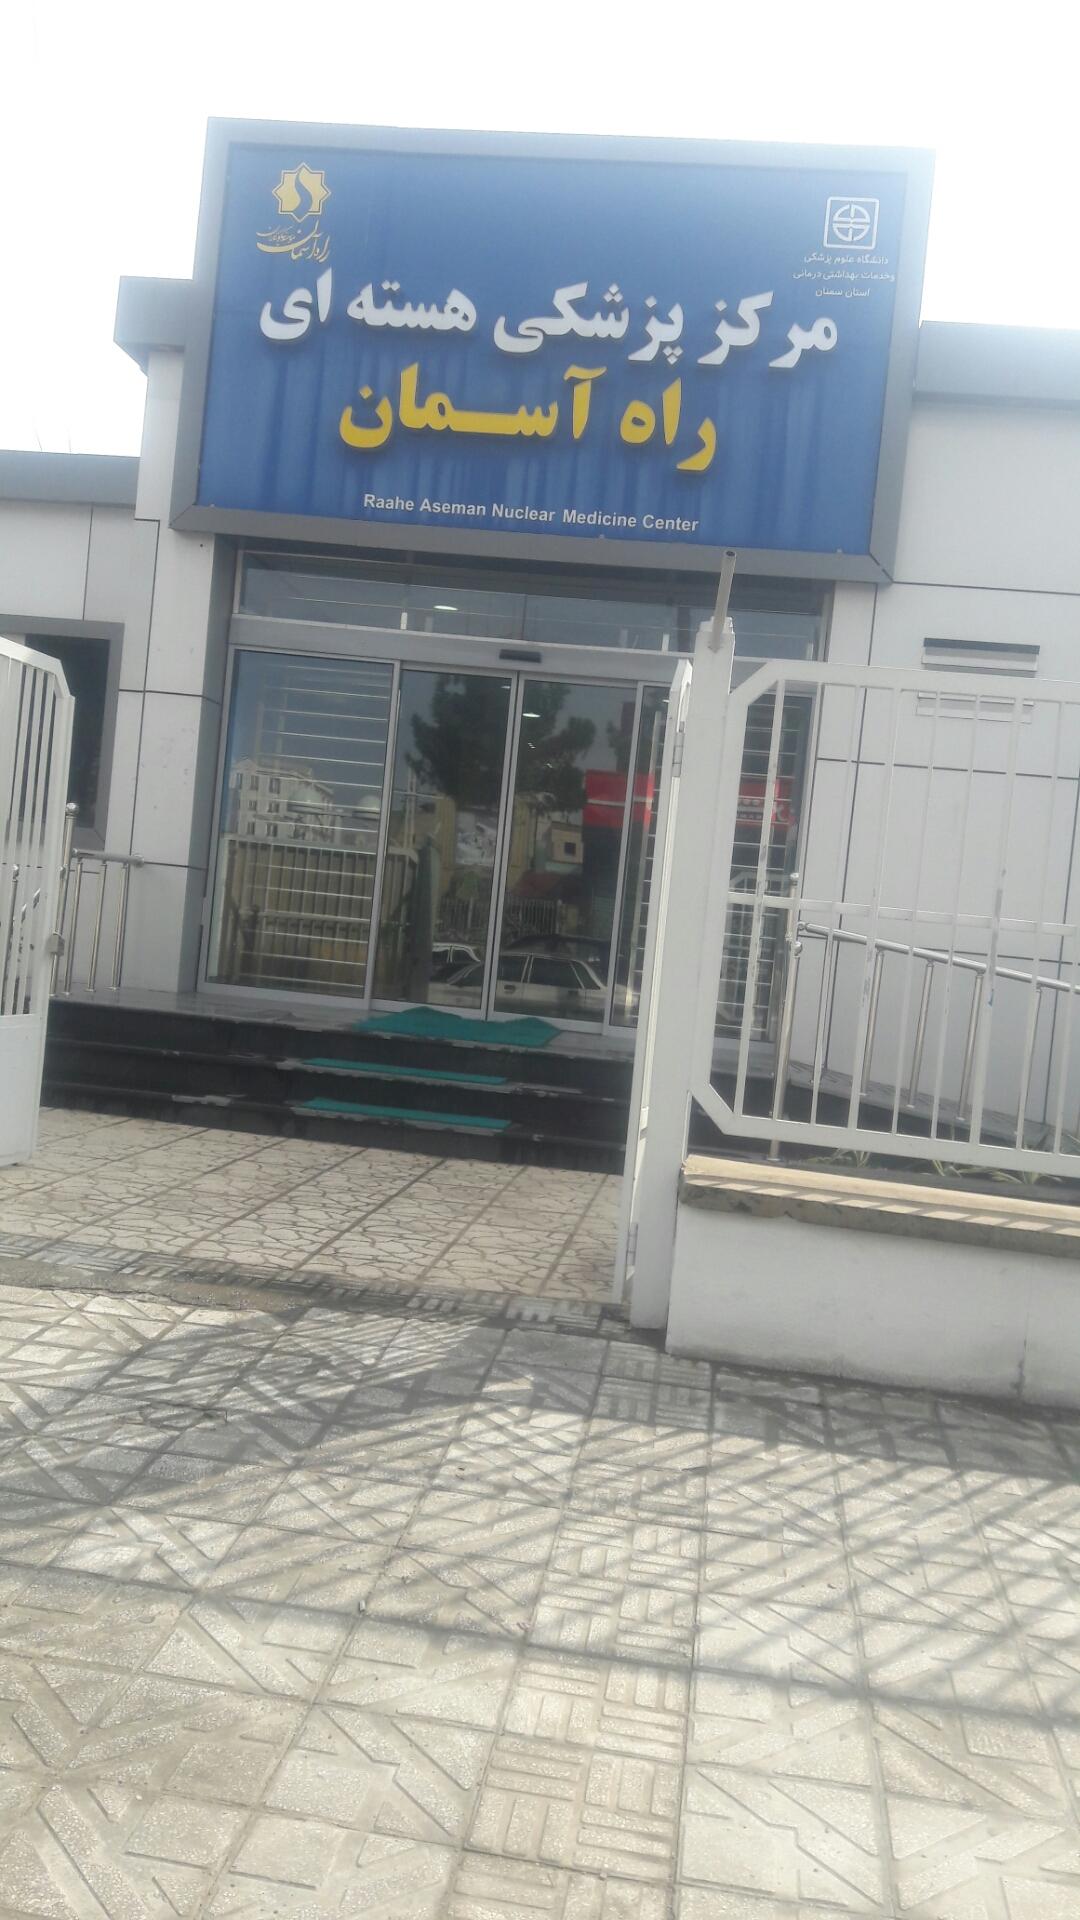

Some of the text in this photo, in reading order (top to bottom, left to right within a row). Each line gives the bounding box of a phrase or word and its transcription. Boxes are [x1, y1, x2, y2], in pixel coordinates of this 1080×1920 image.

[803, 252, 889, 265] دانشگاه علوم پزشکی
[792, 268, 822, 280] درمانی
[822, 270, 858, 281] بهداشتی
[815, 288, 871, 298] استان سمنان
[259, 267, 838, 368] مرکز پزشکی هسته ای
[339, 362, 717, 471] راه آسمان
[364, 494, 699, 532] Raahe Aseman Nuclear Medicine Center
